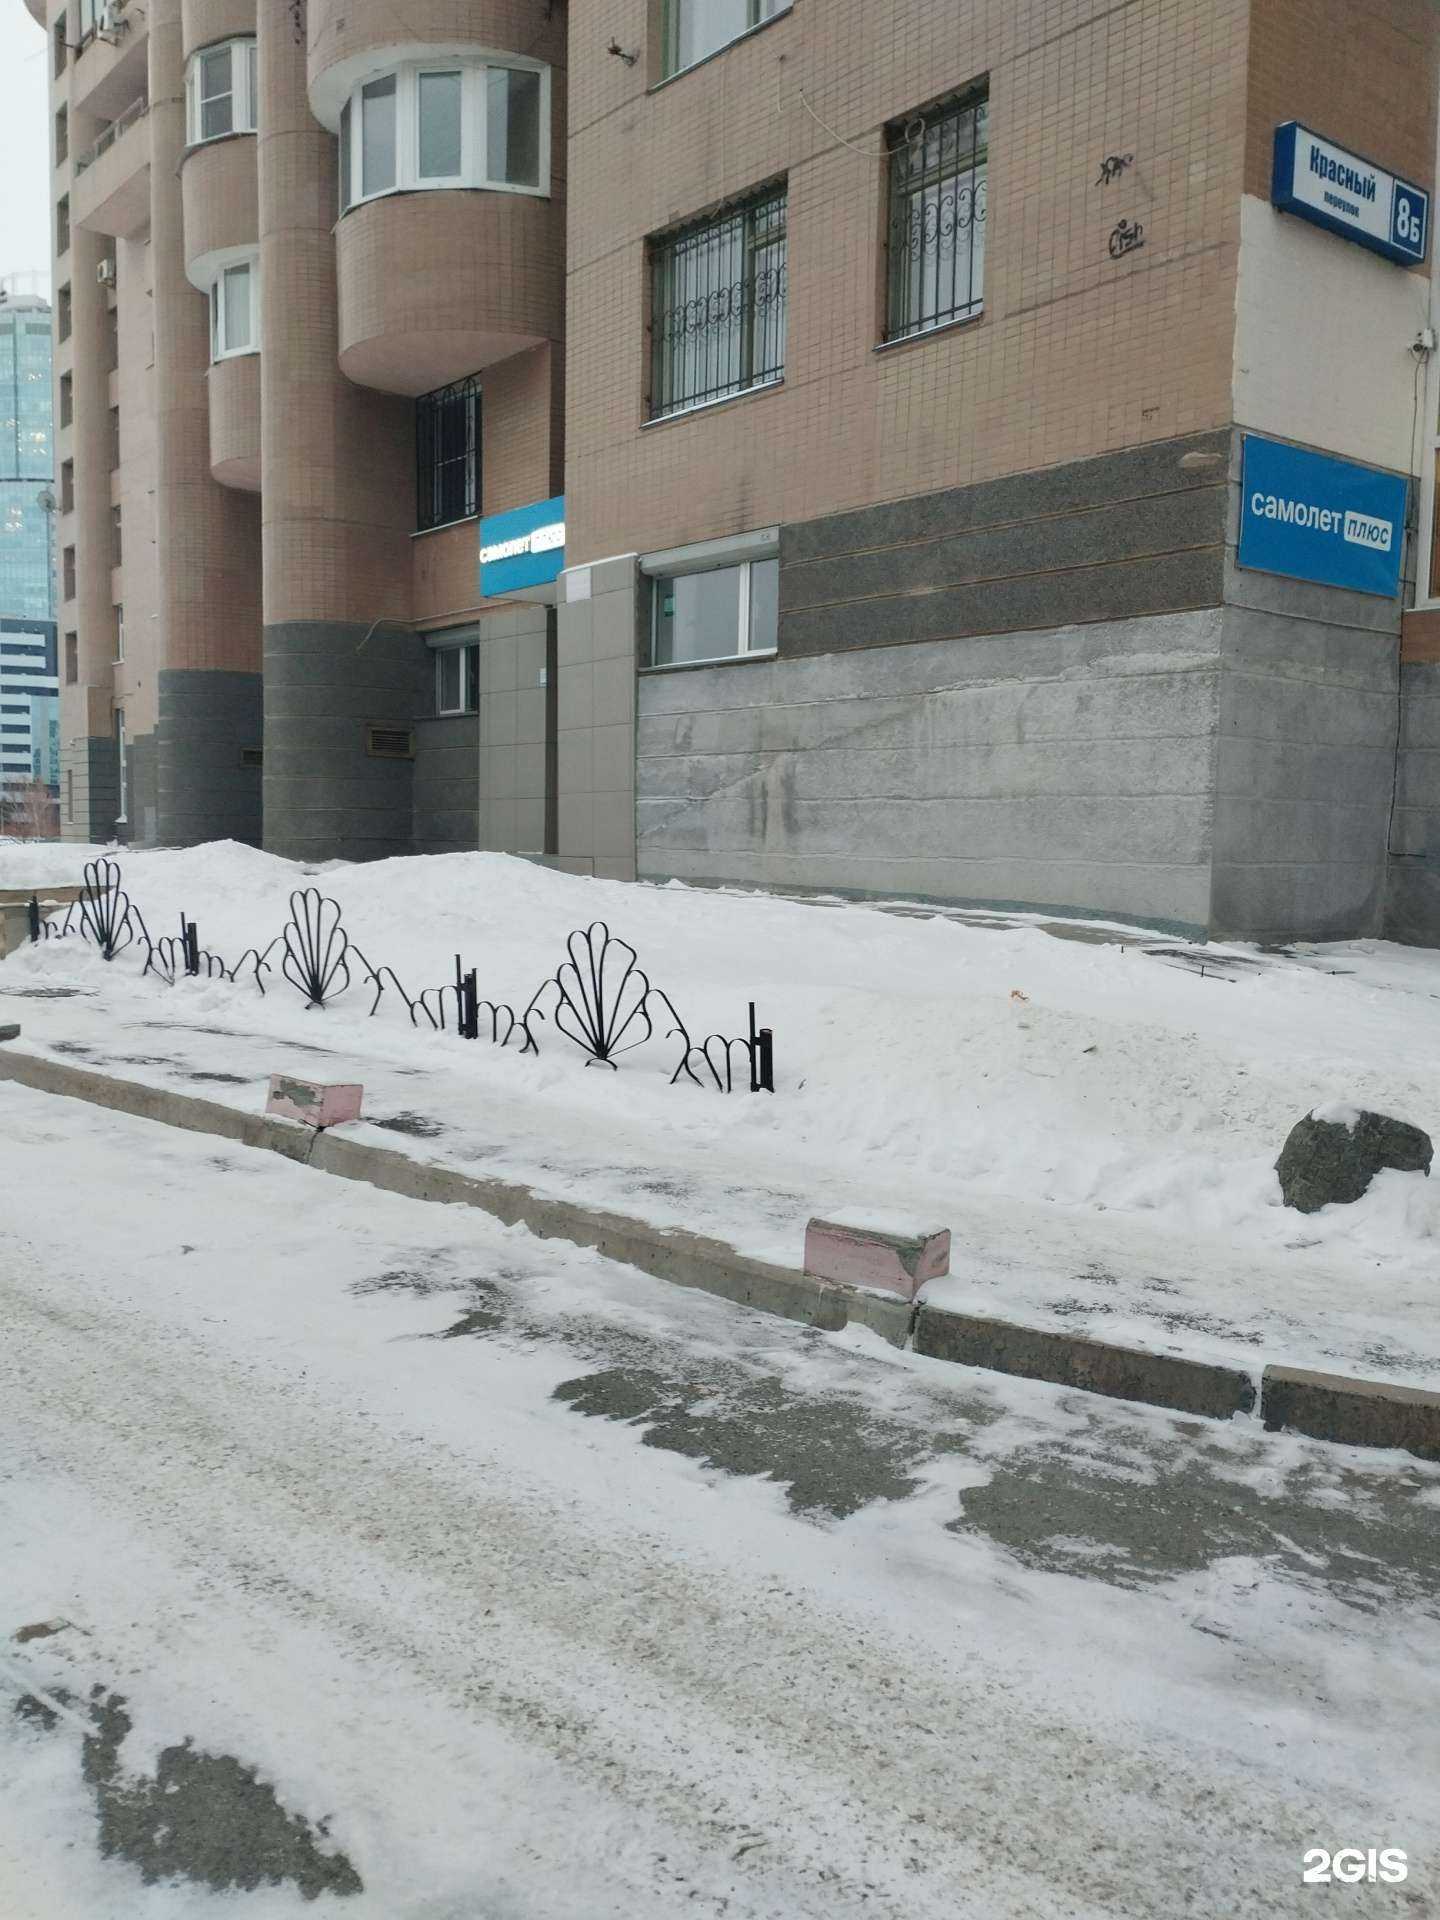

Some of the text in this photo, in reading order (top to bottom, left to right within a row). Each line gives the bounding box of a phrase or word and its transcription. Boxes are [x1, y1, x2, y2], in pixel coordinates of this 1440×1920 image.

[1309, 145, 1377, 202] Красный
[1323, 191, 1360, 218] переулок
[1396, 198, 1421, 243] 8Б
[1251, 492, 1390, 545] самолет плюс
